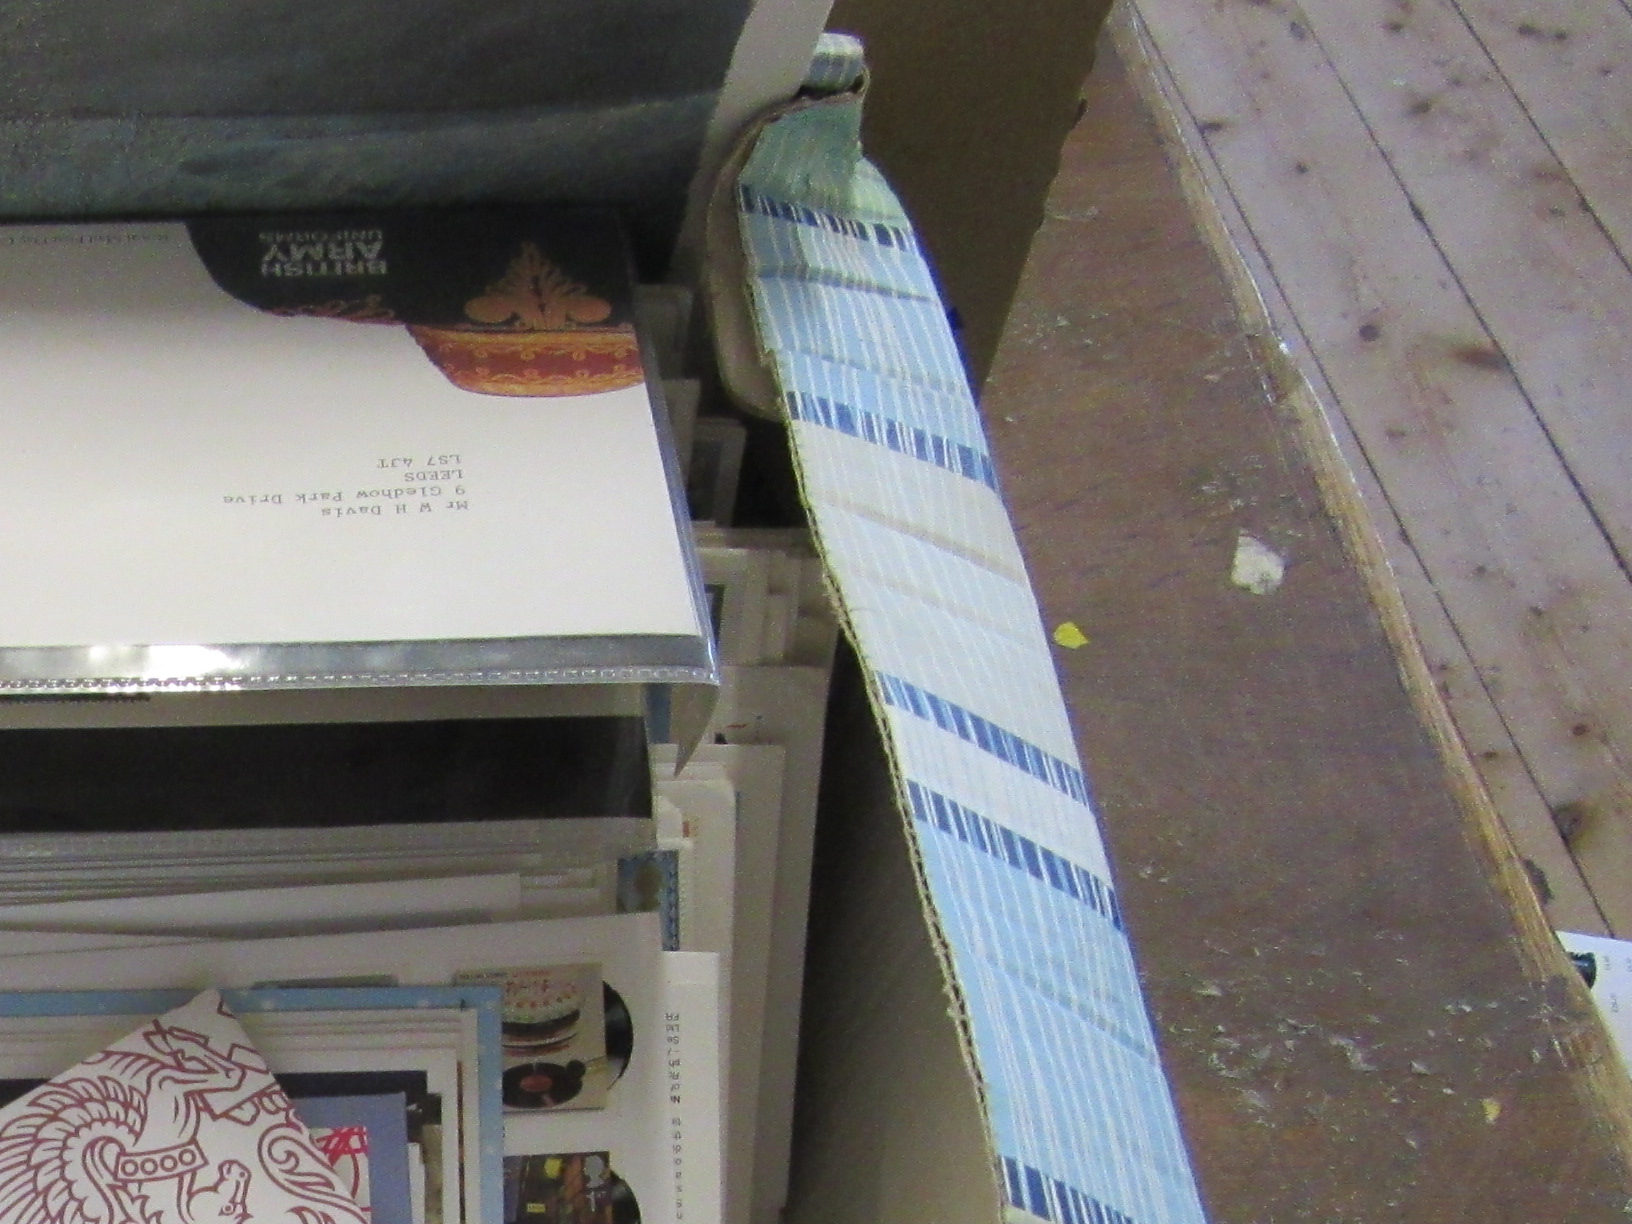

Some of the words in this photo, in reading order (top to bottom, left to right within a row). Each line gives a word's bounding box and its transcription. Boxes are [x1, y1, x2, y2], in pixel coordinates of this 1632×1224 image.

[262, 240, 385, 262] ARMY
[260, 258, 388, 277] BRITISH
[377, 456, 414, 468] 4JT
[426, 453, 462, 465] LS7
[404, 469, 464, 483] LEEDS
[296, 490, 343, 503] Park
[355, 486, 442, 501] Gledhow
[455, 485, 466, 495] 9
[223, 492, 282, 505] Drive
[321, 504, 383, 518] Davis
[446, 500, 470, 512] Mr
